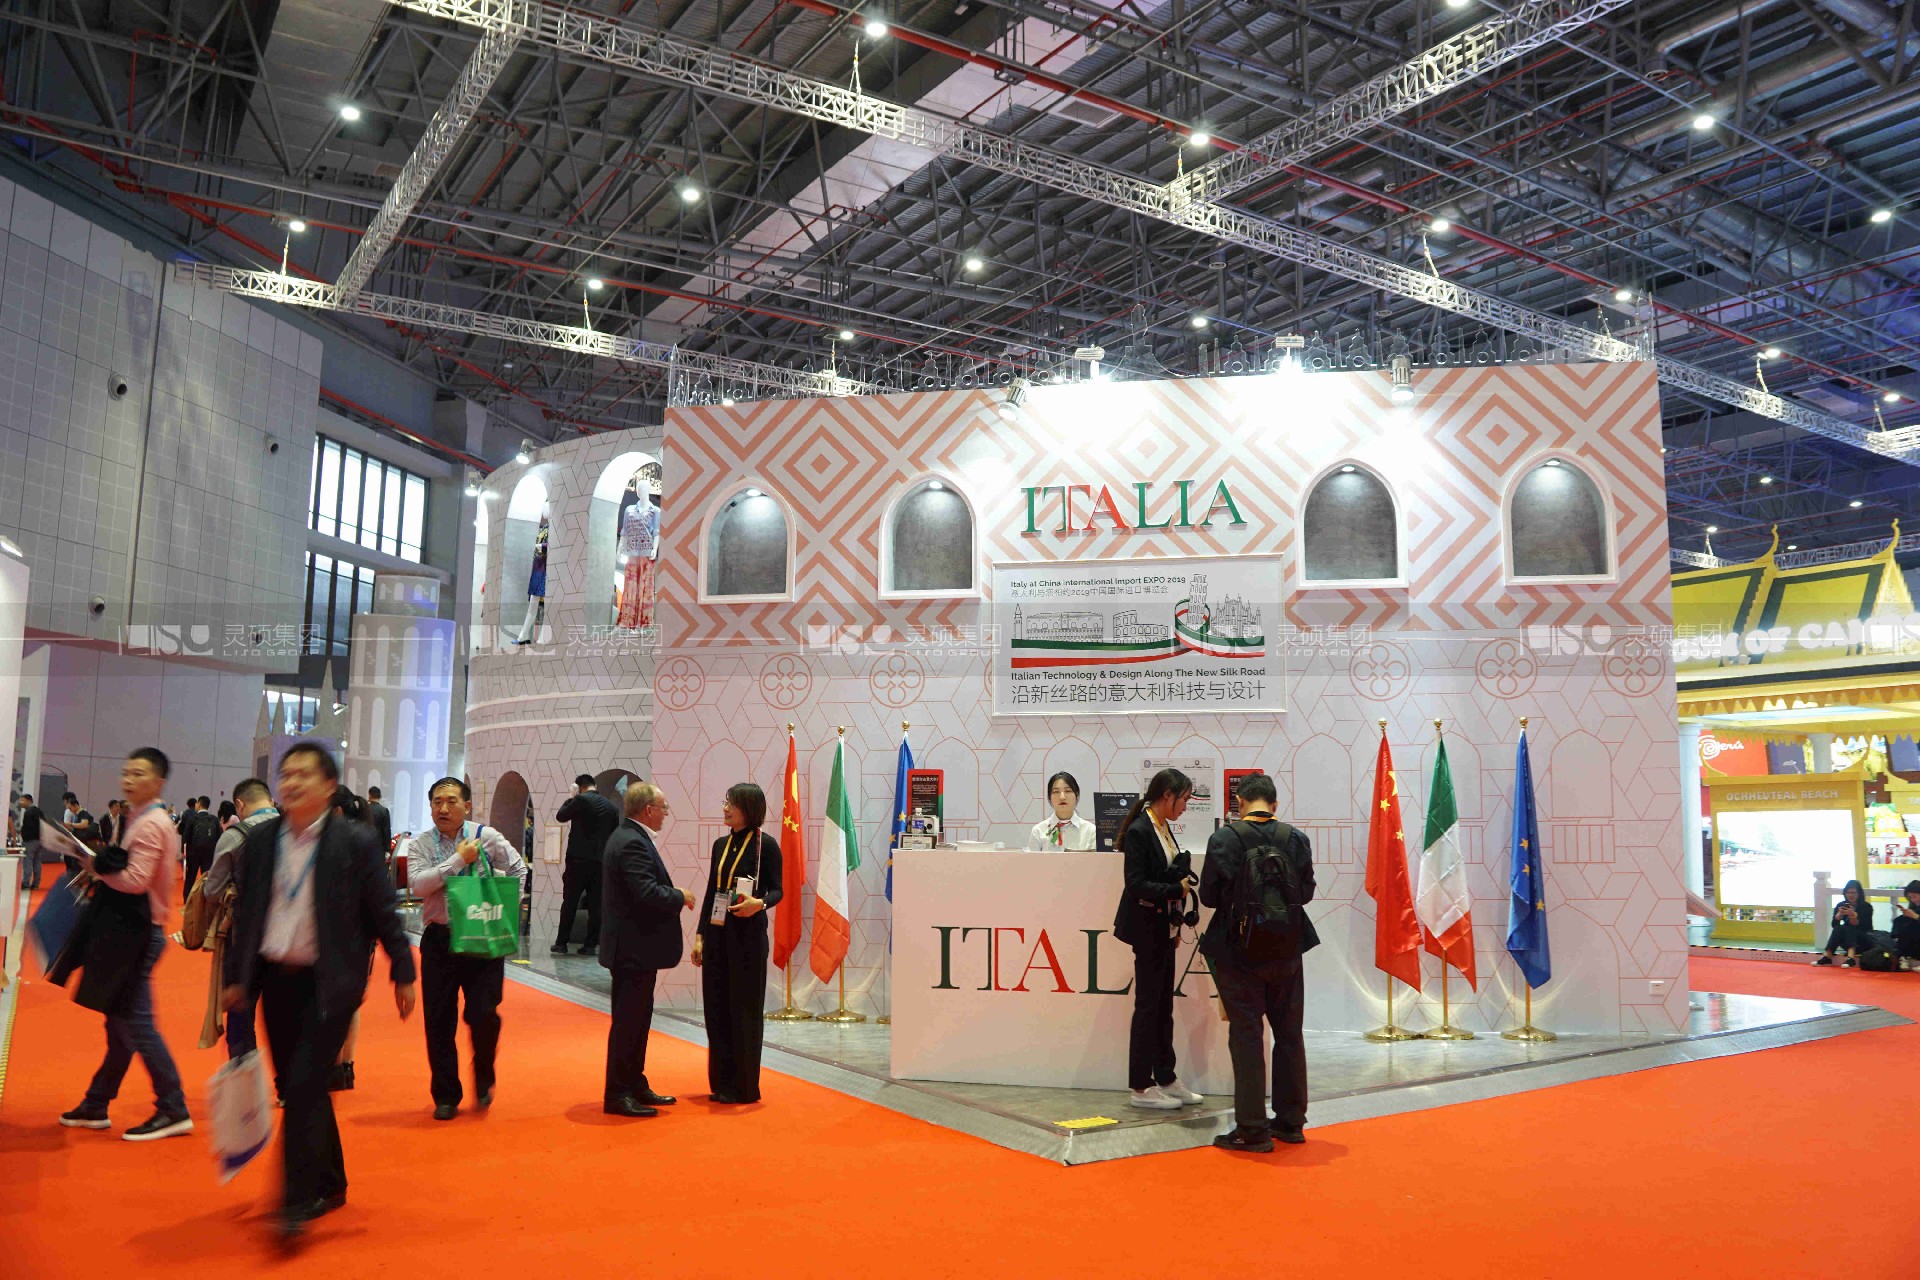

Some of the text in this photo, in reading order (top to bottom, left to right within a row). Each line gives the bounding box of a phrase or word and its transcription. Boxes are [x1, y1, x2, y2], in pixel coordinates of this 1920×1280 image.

[1020, 479, 1248, 533] ITALIA
[1010, 580, 1027, 590] Italy
[1039, 579, 1062, 588] China
[1114, 576, 1142, 587] Import
[1143, 576, 1166, 585] EXPO
[1167, 575, 1187, 584] 2019
[1744, 621, 1792, 655] OF
[1010, 666, 1266, 681] Italian Technology & Design Along The New Silk Road
[1011, 680, 1266, 704] 沿新丝路的意大利科技与设计
[1726, 789, 1839, 801] OCHHEUTEAL BEACH
[930, 926, 1219, 998] ITALA
